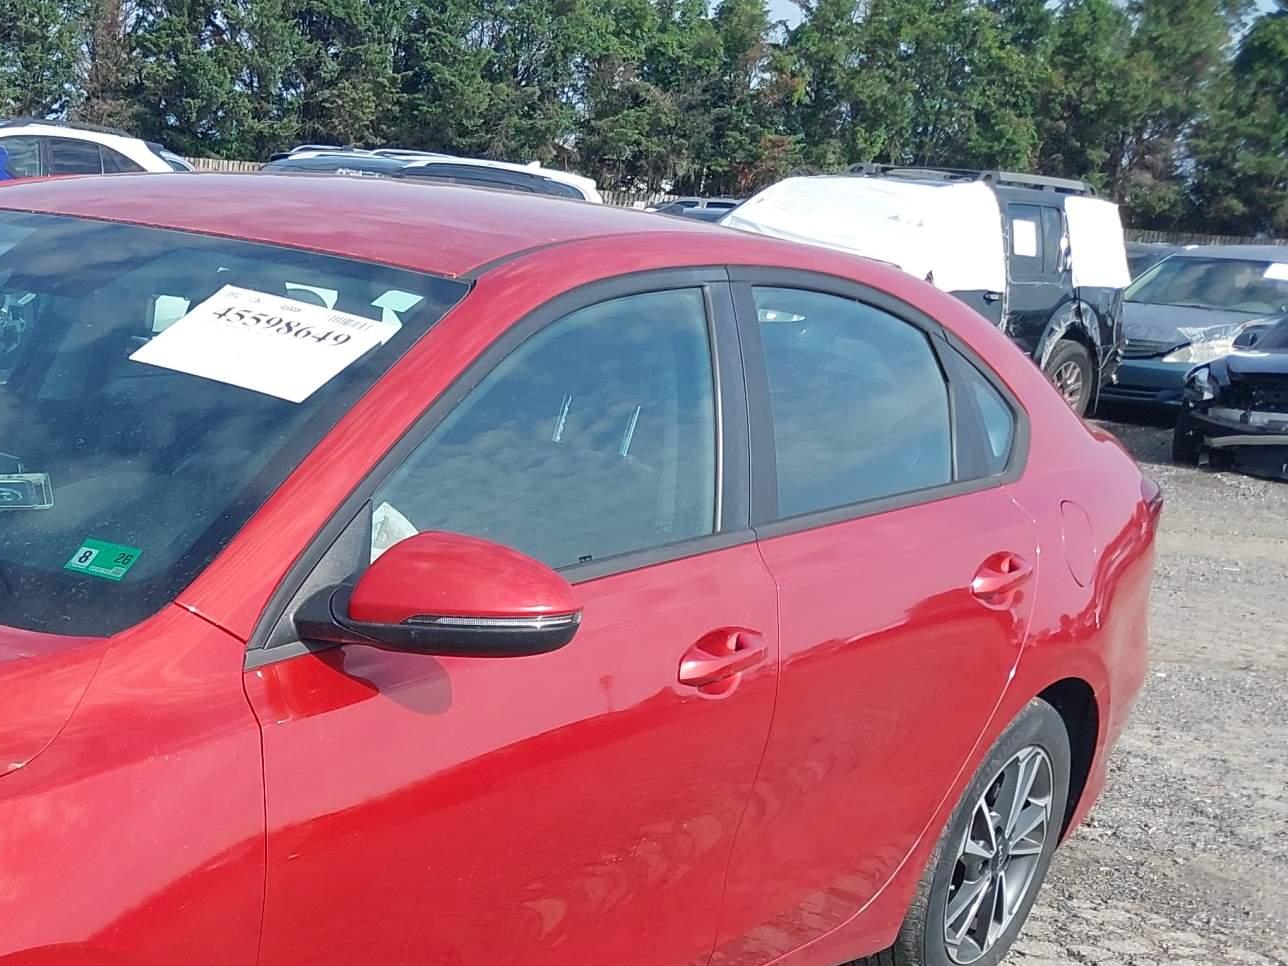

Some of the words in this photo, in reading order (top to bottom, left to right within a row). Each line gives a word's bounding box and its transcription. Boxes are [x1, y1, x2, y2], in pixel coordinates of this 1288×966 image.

[213, 306, 352, 346] 45598649
[78, 550, 93, 564] 8
[114, 552, 134, 566] 26
